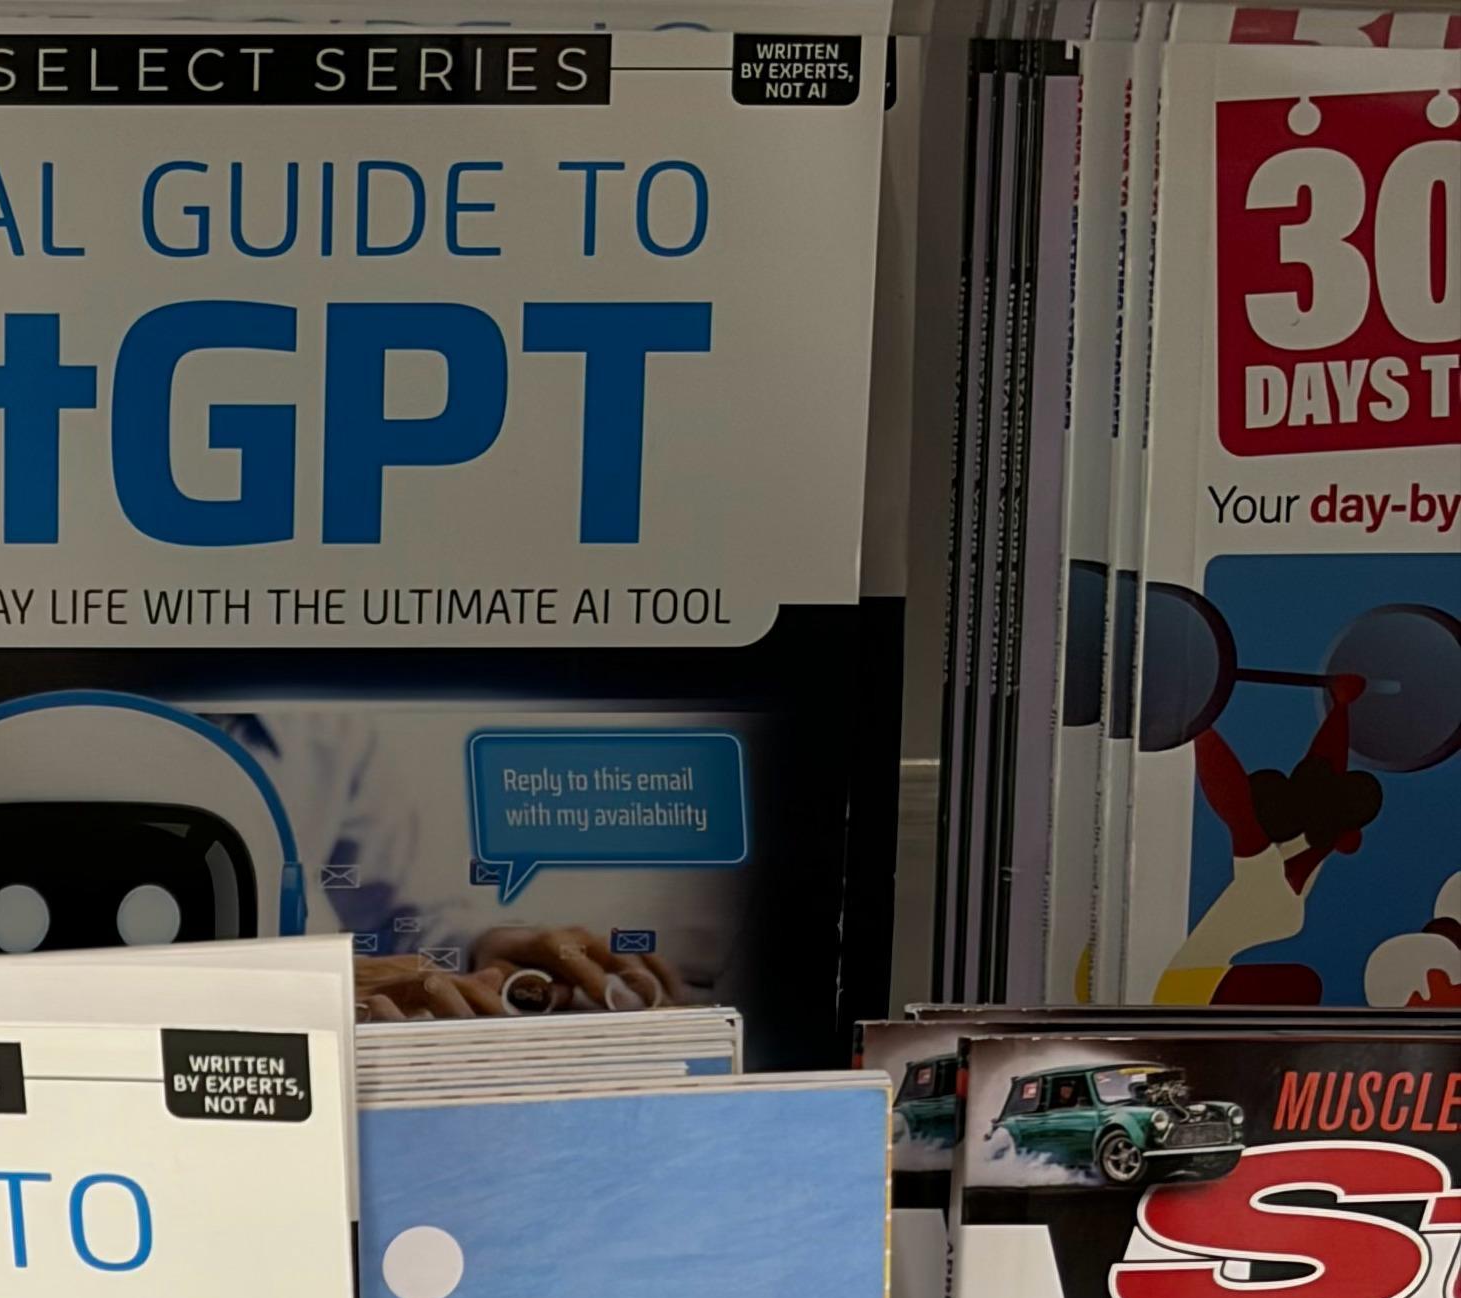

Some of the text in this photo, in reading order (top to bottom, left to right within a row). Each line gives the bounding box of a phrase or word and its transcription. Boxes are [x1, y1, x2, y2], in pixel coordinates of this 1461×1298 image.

[756, 43, 840, 60] WRITTEN
[316, 48, 589, 92] SERIES
[741, 63, 855, 83] BY EXPERTS,
[765, 81, 827, 99] NOT AI
[142, 160, 504, 258] GUIDE
[558, 160, 710, 258] TO
[1245, 357, 1410, 430] DAYS
[1207, 485, 1300, 524] Your
[50, 587, 128, 625] LIFE
[144, 587, 252, 625] WITH
[267, 587, 347, 625] THE
[363, 587, 558, 625] ULTIMATE
[572, 587, 611, 625] AI
[626, 587, 731, 625] TOOL
[502, 767, 695, 799] Reply to this email
[505, 803, 708, 833] with my availability
[188, 1054, 286, 1076] WRITTEN
[173, 1075, 305, 1100] BY EXPERTS,
[203, 1095, 275, 1115] NOT AI
